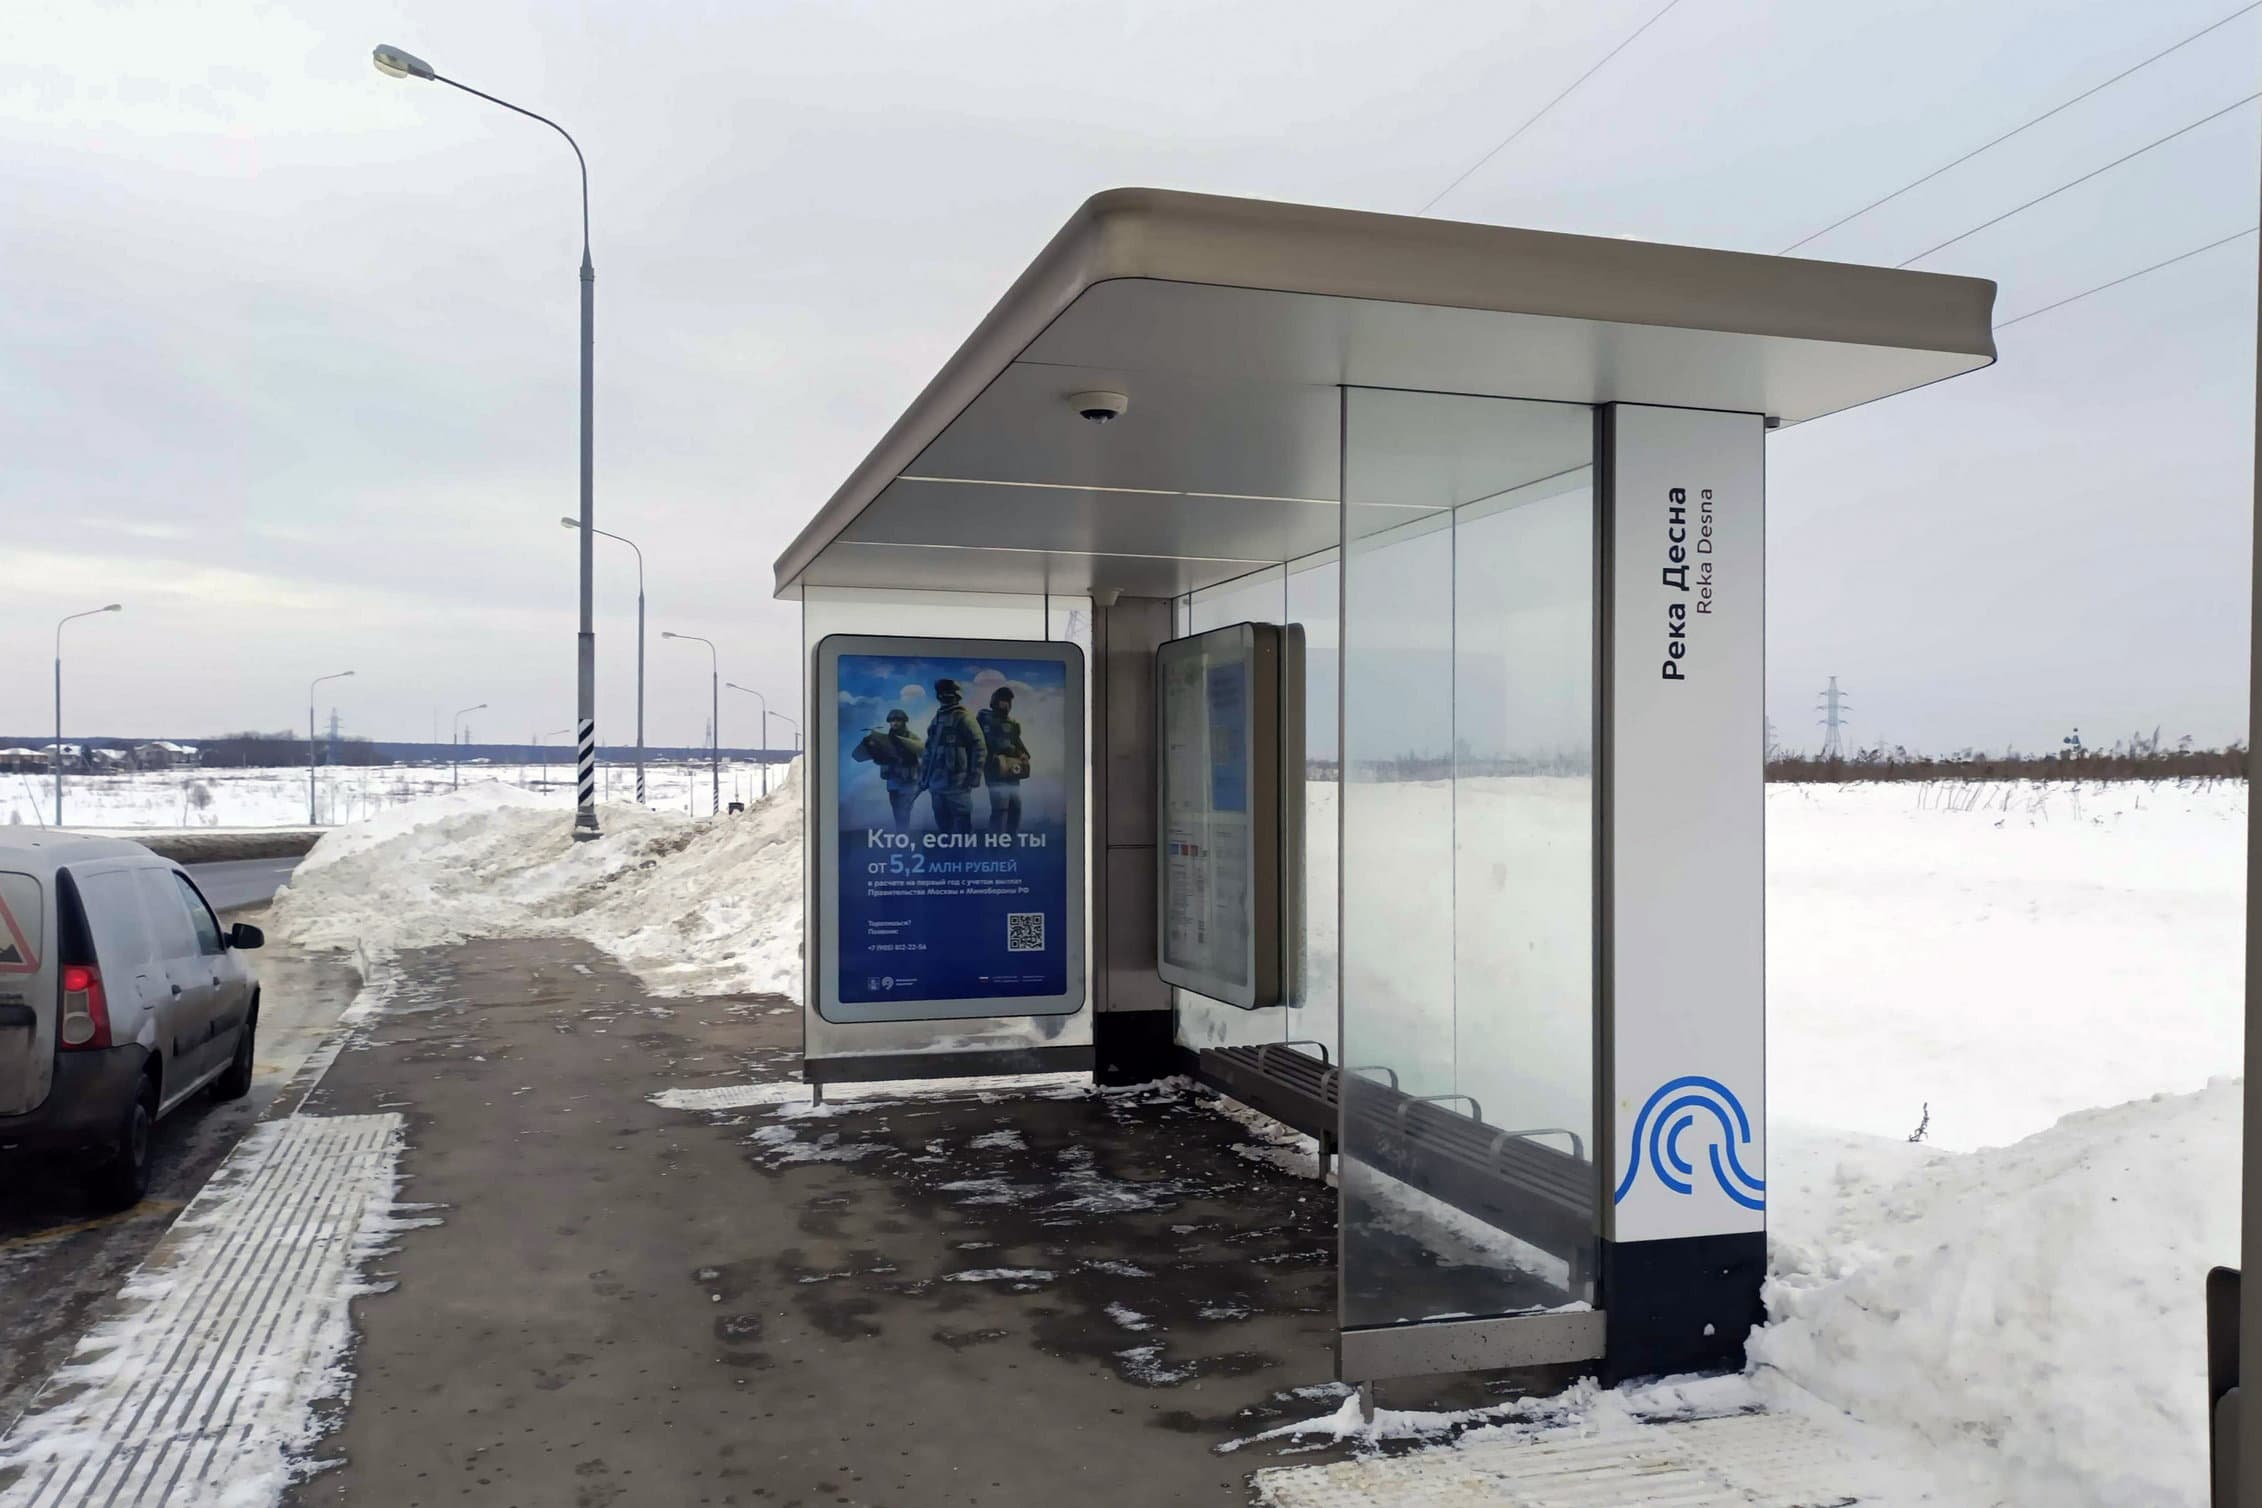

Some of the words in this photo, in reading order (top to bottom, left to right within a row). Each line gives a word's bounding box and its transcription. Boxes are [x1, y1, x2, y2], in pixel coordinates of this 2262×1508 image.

[1662, 487, 1690, 591] Десна
[1697, 488, 1713, 554] Desna
[1696, 562, 1713, 614] Reka
[1662, 603, 1686, 681] Река
[867, 828, 916, 852] Кто,
[922, 833, 977, 849] если
[984, 833, 1012, 848] не
[1017, 833, 1046, 848] ты
[889, 853, 926, 877] 5,2
[965, 859, 1017, 873] РУБЛЕЙ
